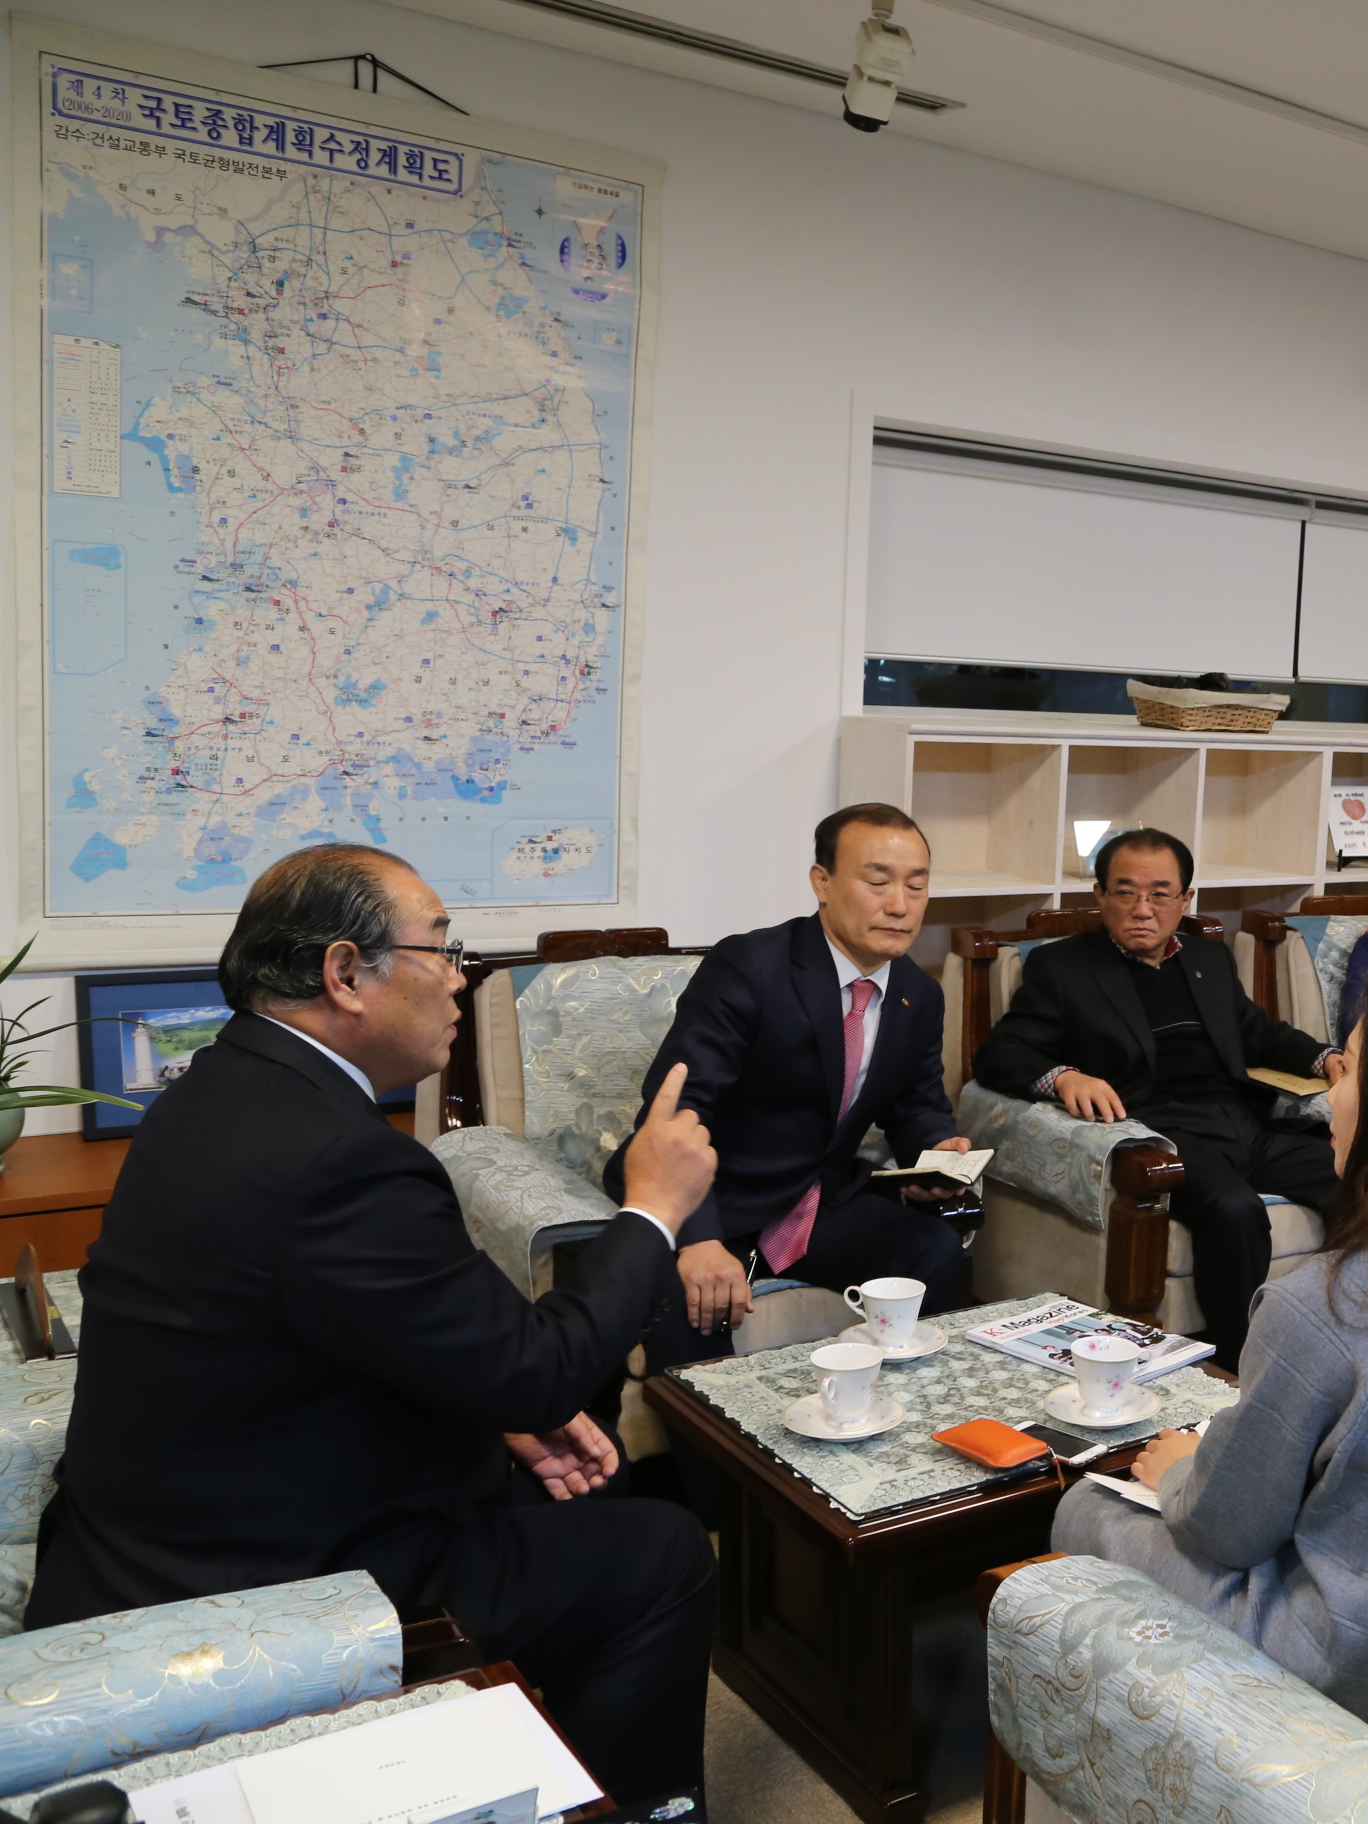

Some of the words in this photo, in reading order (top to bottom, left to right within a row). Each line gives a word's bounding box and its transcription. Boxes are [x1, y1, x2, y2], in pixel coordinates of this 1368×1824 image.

[61, 96, 133, 124] (2006~2020)
[136, 92, 454, 186] 국토종합계획수정계획도
[172, 144, 290, 182] 국토균형발전본부
[1001, 1303, 1080, 1331] Magazine
